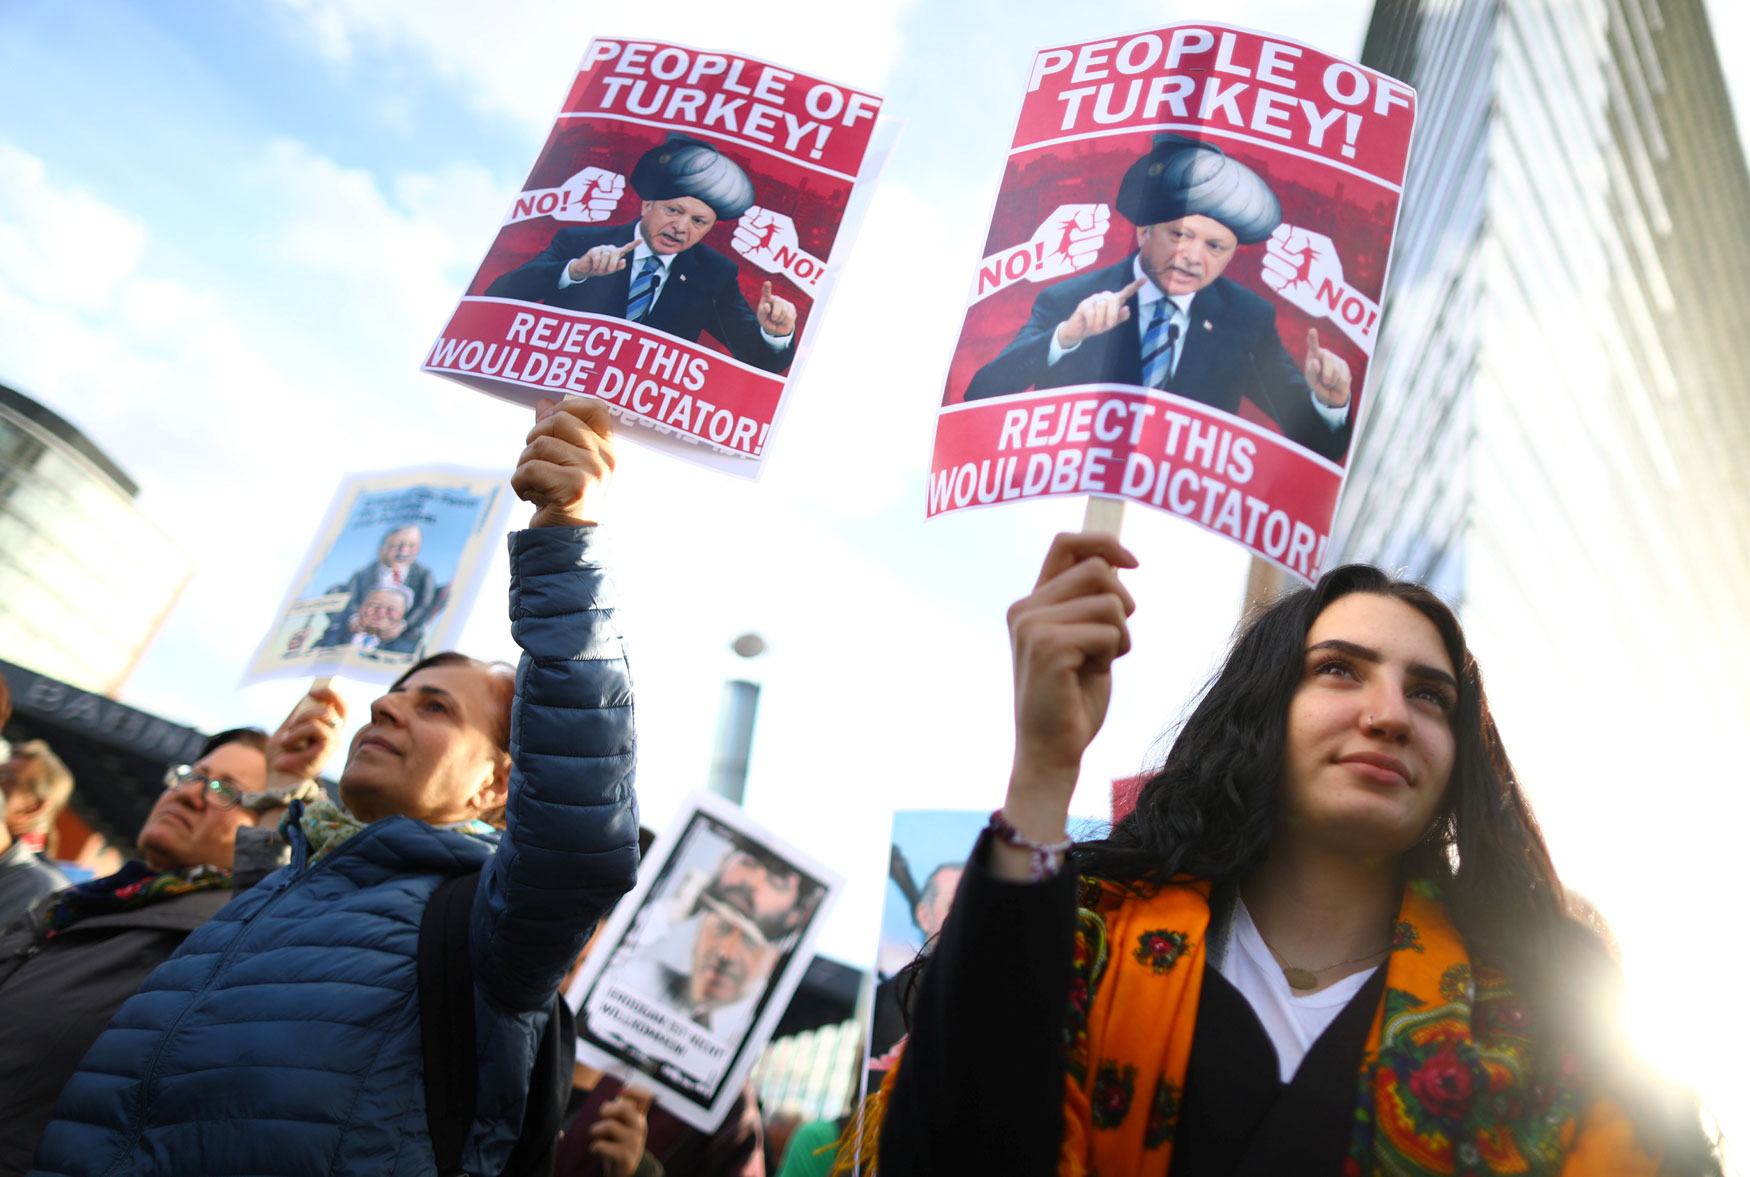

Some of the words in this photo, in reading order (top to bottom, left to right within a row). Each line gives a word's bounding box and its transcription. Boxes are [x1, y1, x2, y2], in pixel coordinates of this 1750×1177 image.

[580, 41, 795, 105] PEOPLE
[805, 84, 882, 128] OF
[1027, 28, 1303, 93] PEOPLE
[1322, 63, 1415, 118] OF
[600, 76, 833, 161] TURKEY!
[1058, 74, 1364, 160] TURKEY!
[511, 190, 571, 218] NO!
[772, 246, 825, 285] NO!
[977, 242, 1044, 295] NO!
[1316, 279, 1378, 336] NO!
[506, 312, 632, 361] REJECT
[636, 338, 710, 392] THIS
[430, 338, 597, 392] WOULDBE
[596, 365, 770, 455] DICTATOR!
[998, 399, 1156, 451] REJECT
[1164, 410, 1257, 484] THIS
[929, 447, 1112, 515] WOULDBE
[1120, 451, 1329, 581] DICTATOR!
